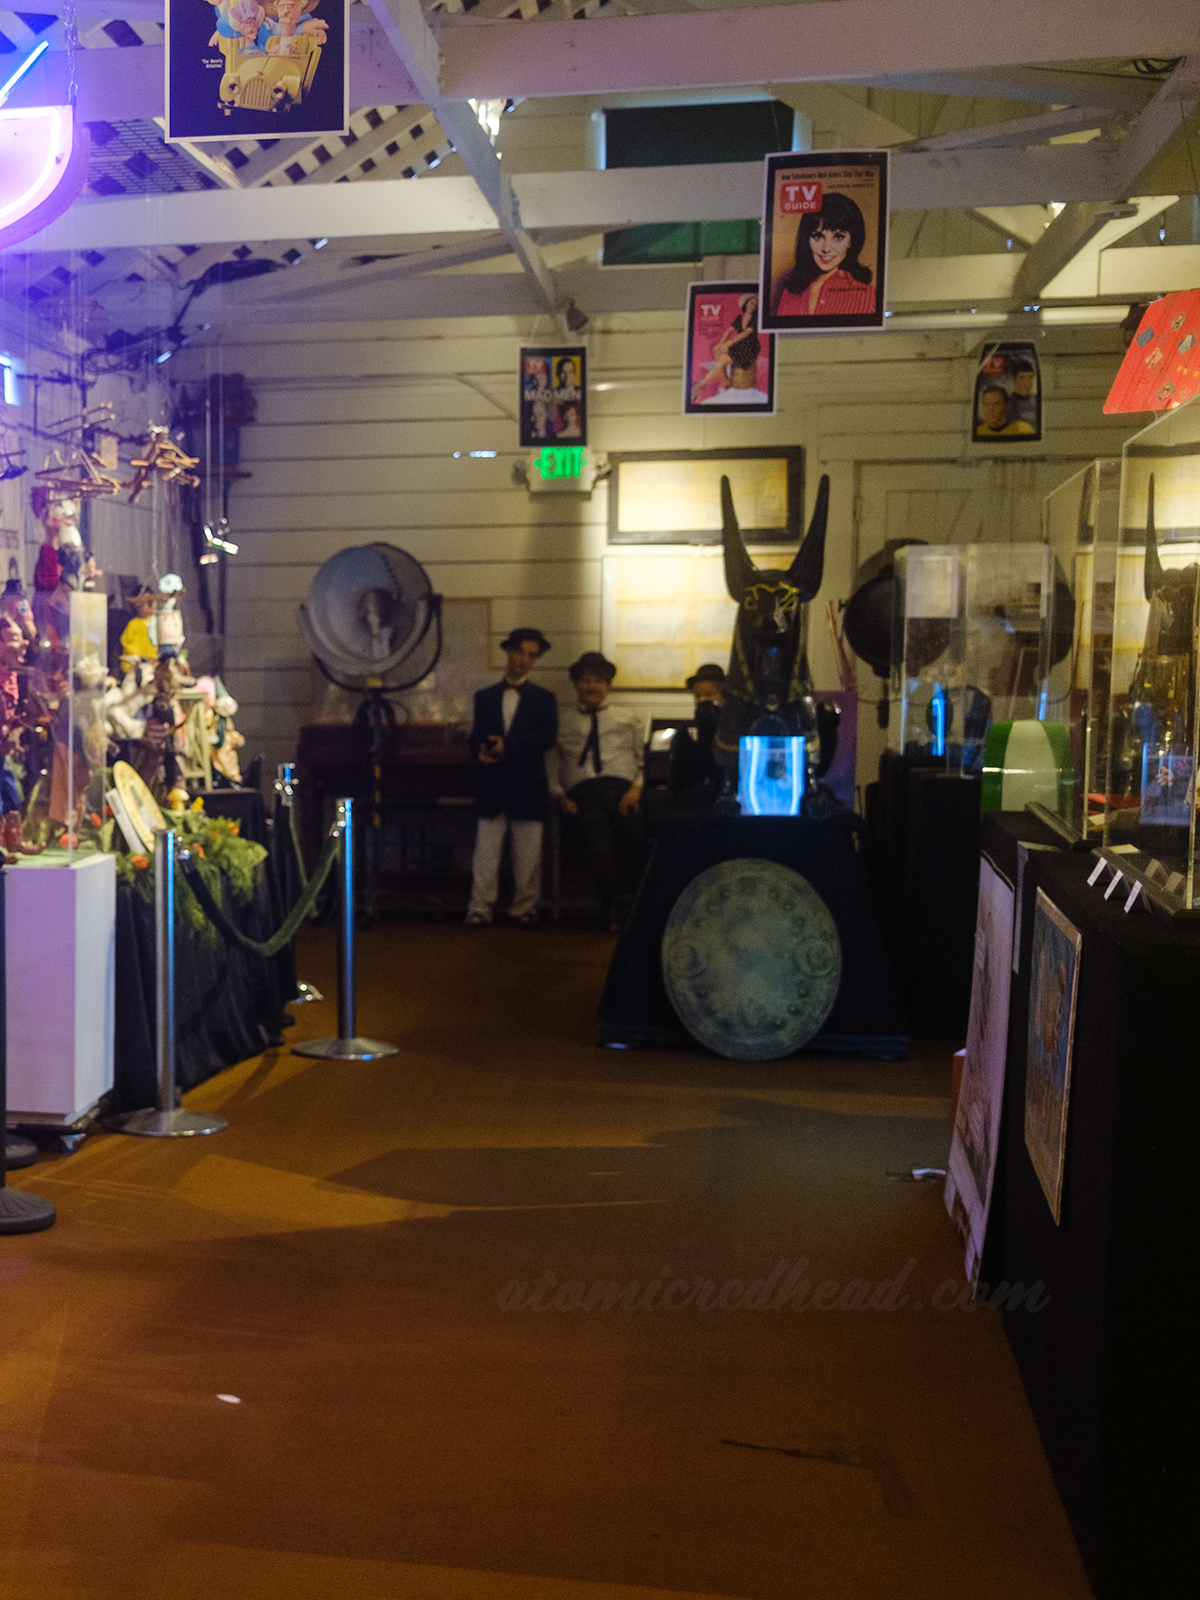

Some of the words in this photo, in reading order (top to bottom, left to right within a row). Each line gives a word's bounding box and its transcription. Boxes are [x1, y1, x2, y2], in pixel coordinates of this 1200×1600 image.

[785, 185, 817, 202] TV
[784, 201, 816, 210] GUIDE
[700, 304, 721, 316] TV
[540, 446, 584, 479] EXIT
